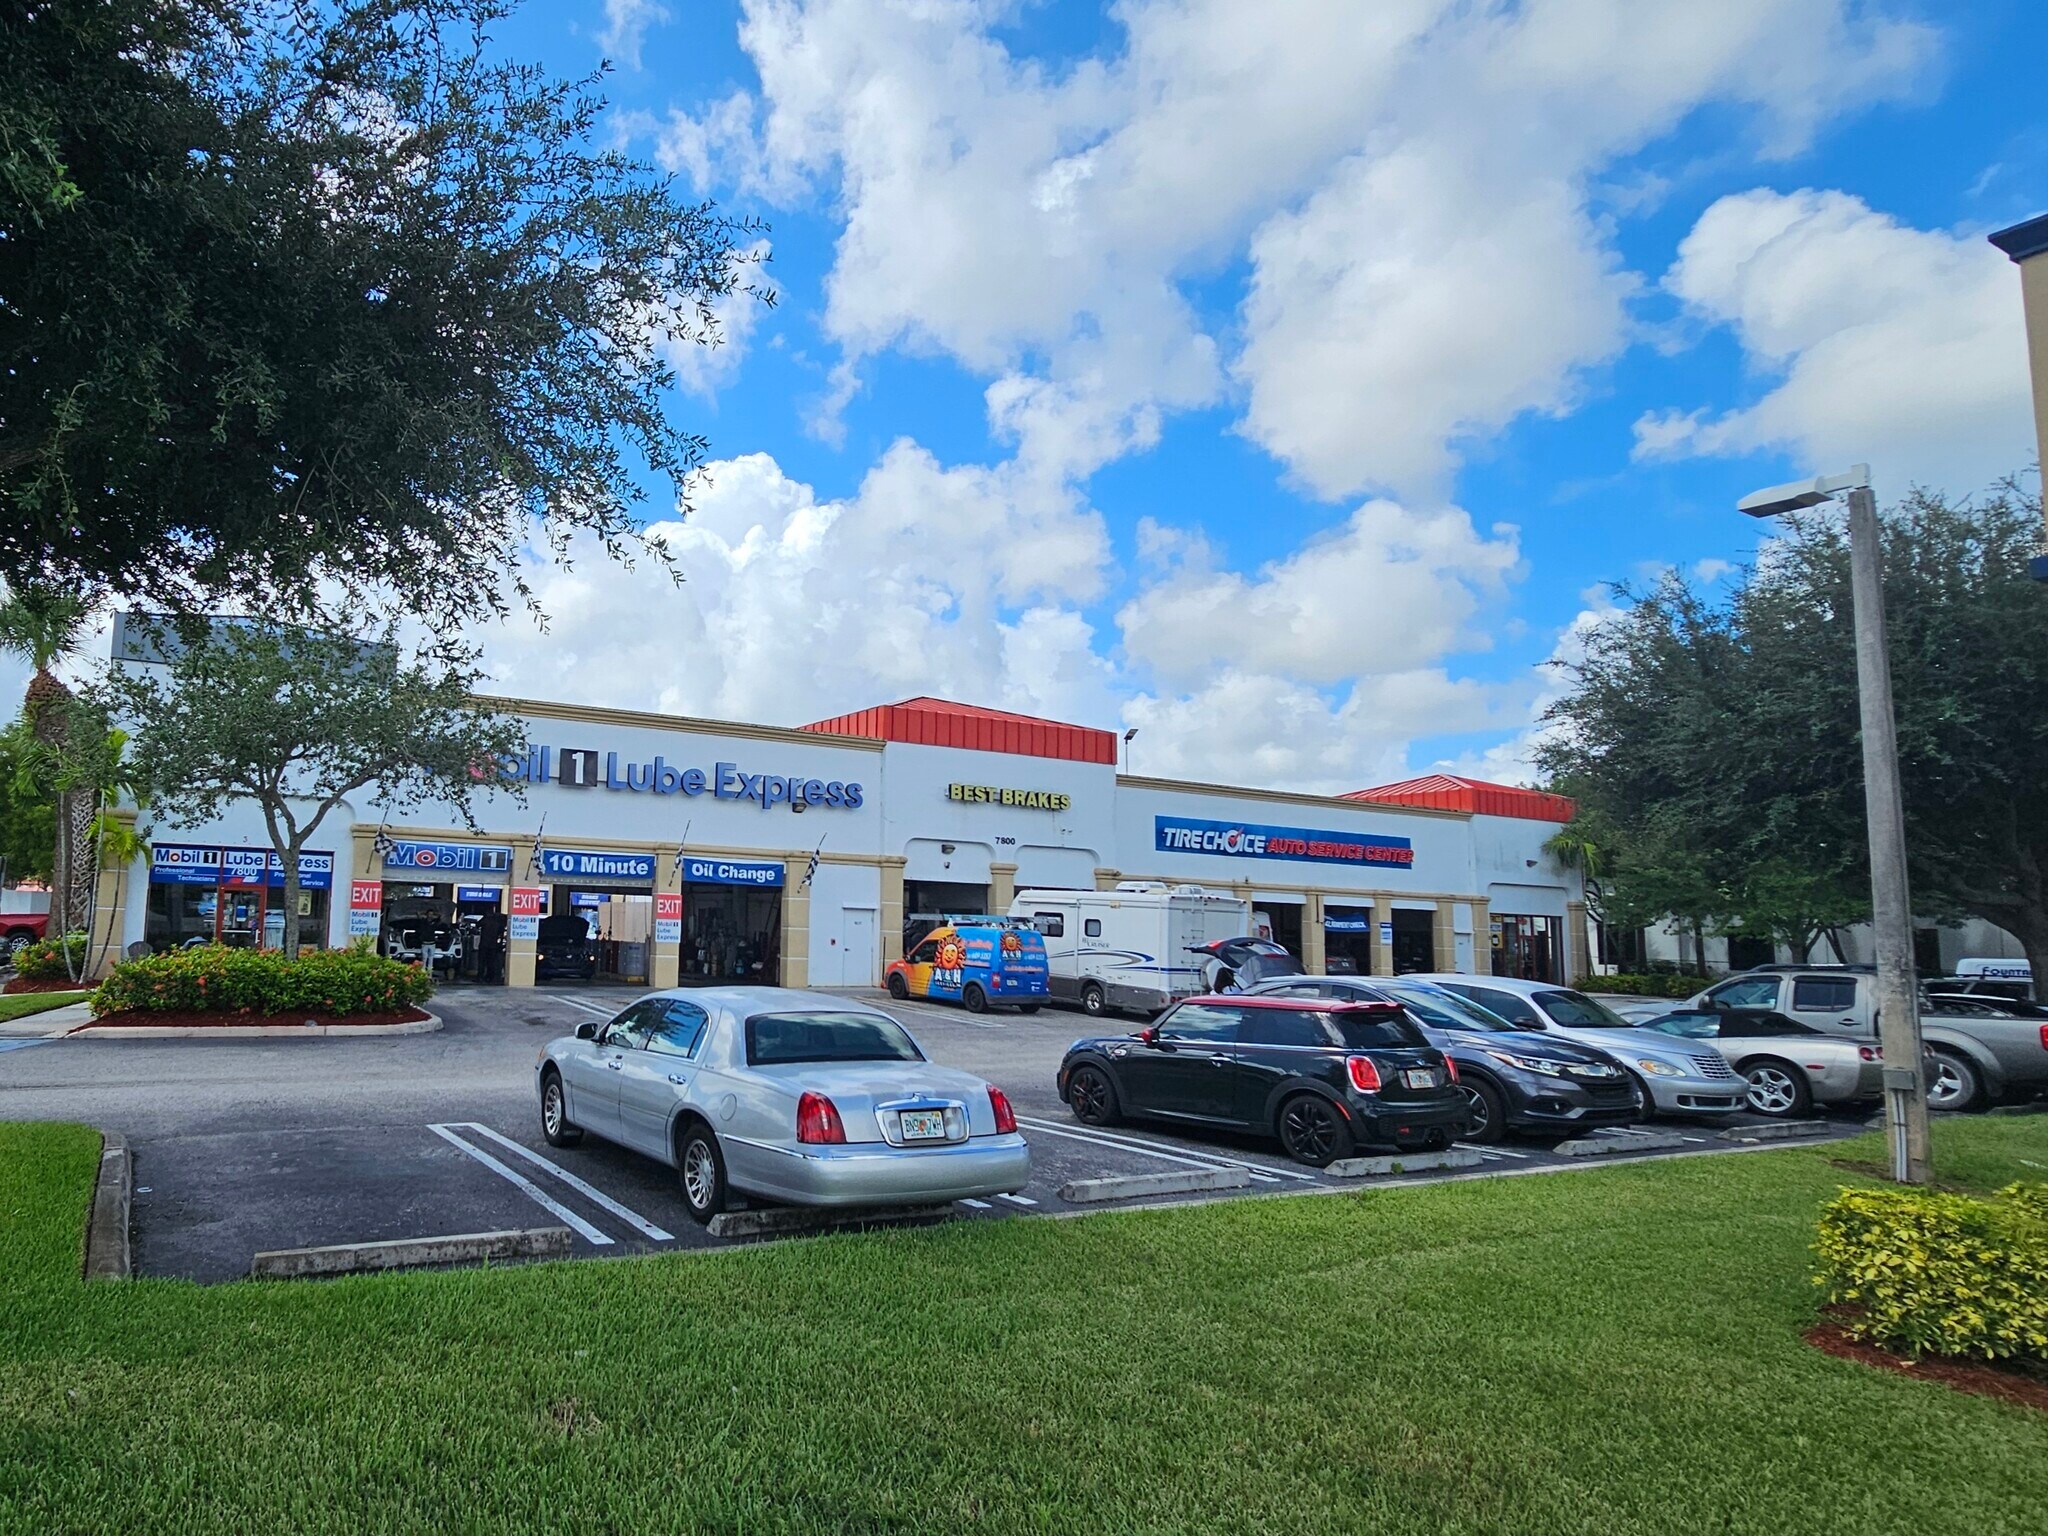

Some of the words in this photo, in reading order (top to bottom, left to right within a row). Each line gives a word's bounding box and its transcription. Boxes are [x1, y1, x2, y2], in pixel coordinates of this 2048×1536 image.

[607, 752, 706, 796] Lube
[714, 762, 863, 809] Express
[949, 783, 998, 803] BEST
[1000, 788, 1071, 812] BRAKES
[995, 836, 1016, 846] 7800
[155, 849, 200, 864] Mobil
[225, 852, 264, 866] Lube
[269, 854, 329, 869] Eress
[387, 844, 475, 869] Mobil
[1268, 838, 1307, 855] AUTO
[1308, 840, 1363, 860] SERVICE
[1364, 845, 1414, 863] CENTER
[154, 866, 195, 874] Professional
[230, 866, 258, 876] 7800
[549, 854, 574, 872] 10
[580, 856, 649, 876] Minute
[691, 863, 713, 877] Oil
[718, 865, 775, 882] Change
[274, 871, 312, 879] Proonal
[352, 887, 381, 903] EXIT
[513, 893, 539, 909] EXIT
[657, 899, 681, 914] EXIT
[934, 967, 942, 981] A
[953, 969, 961, 984] H
